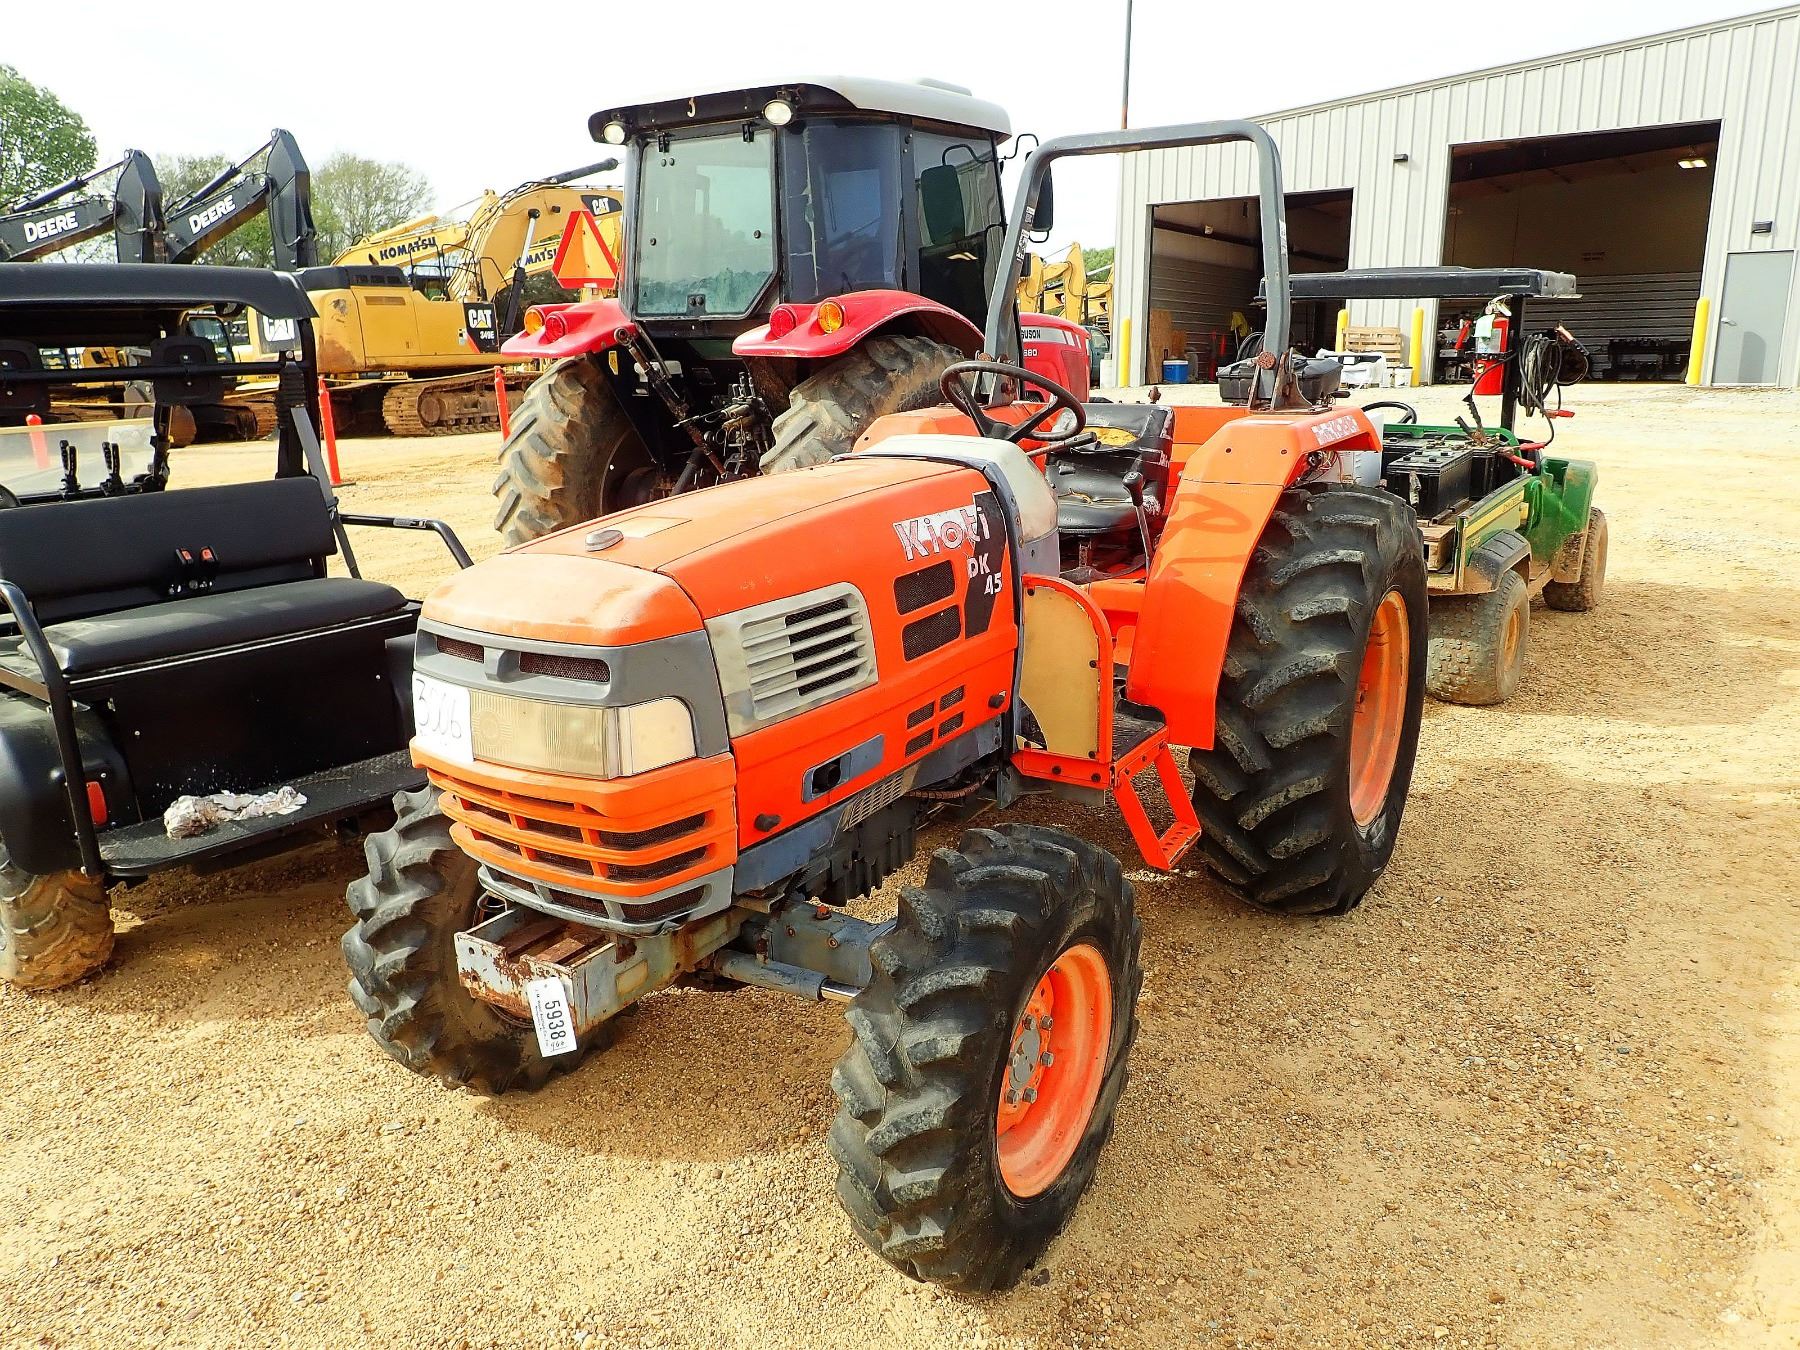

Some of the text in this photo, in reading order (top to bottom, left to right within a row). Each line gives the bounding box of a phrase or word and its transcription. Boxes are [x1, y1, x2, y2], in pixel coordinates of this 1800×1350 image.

[188, 195, 236, 235] DEERE
[592, 197, 610, 216] CAT
[24, 211, 79, 243] DEERE
[380, 236, 436, 261] KOMATSU
[468, 309, 492, 328] CAT
[895, 506, 990, 562] Kioti
[966, 553, 991, 578] DK
[983, 572, 1003, 595] 45
[544, 1000, 567, 1041] 5938
